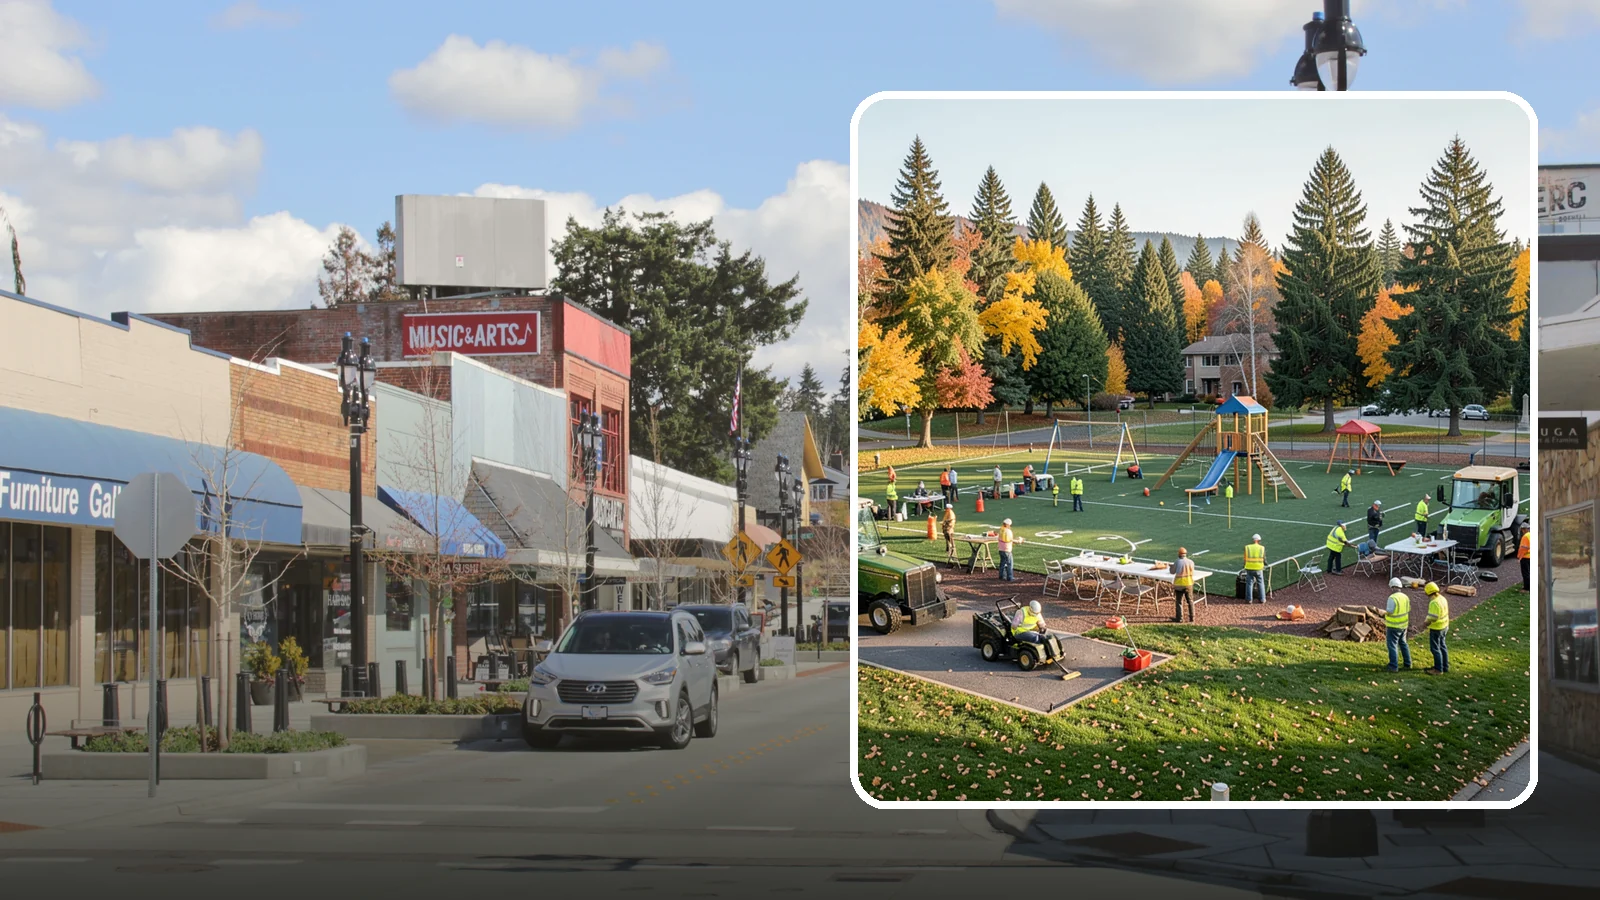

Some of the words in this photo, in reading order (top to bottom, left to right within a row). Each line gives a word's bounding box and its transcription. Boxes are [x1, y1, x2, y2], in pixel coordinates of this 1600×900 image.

[408, 322, 520, 349] MUSIC&ARTS
[0, 471, 79, 515] Furniture
[89, 482, 121, 519] Gal
[453, 563, 478, 574] SUSHI
